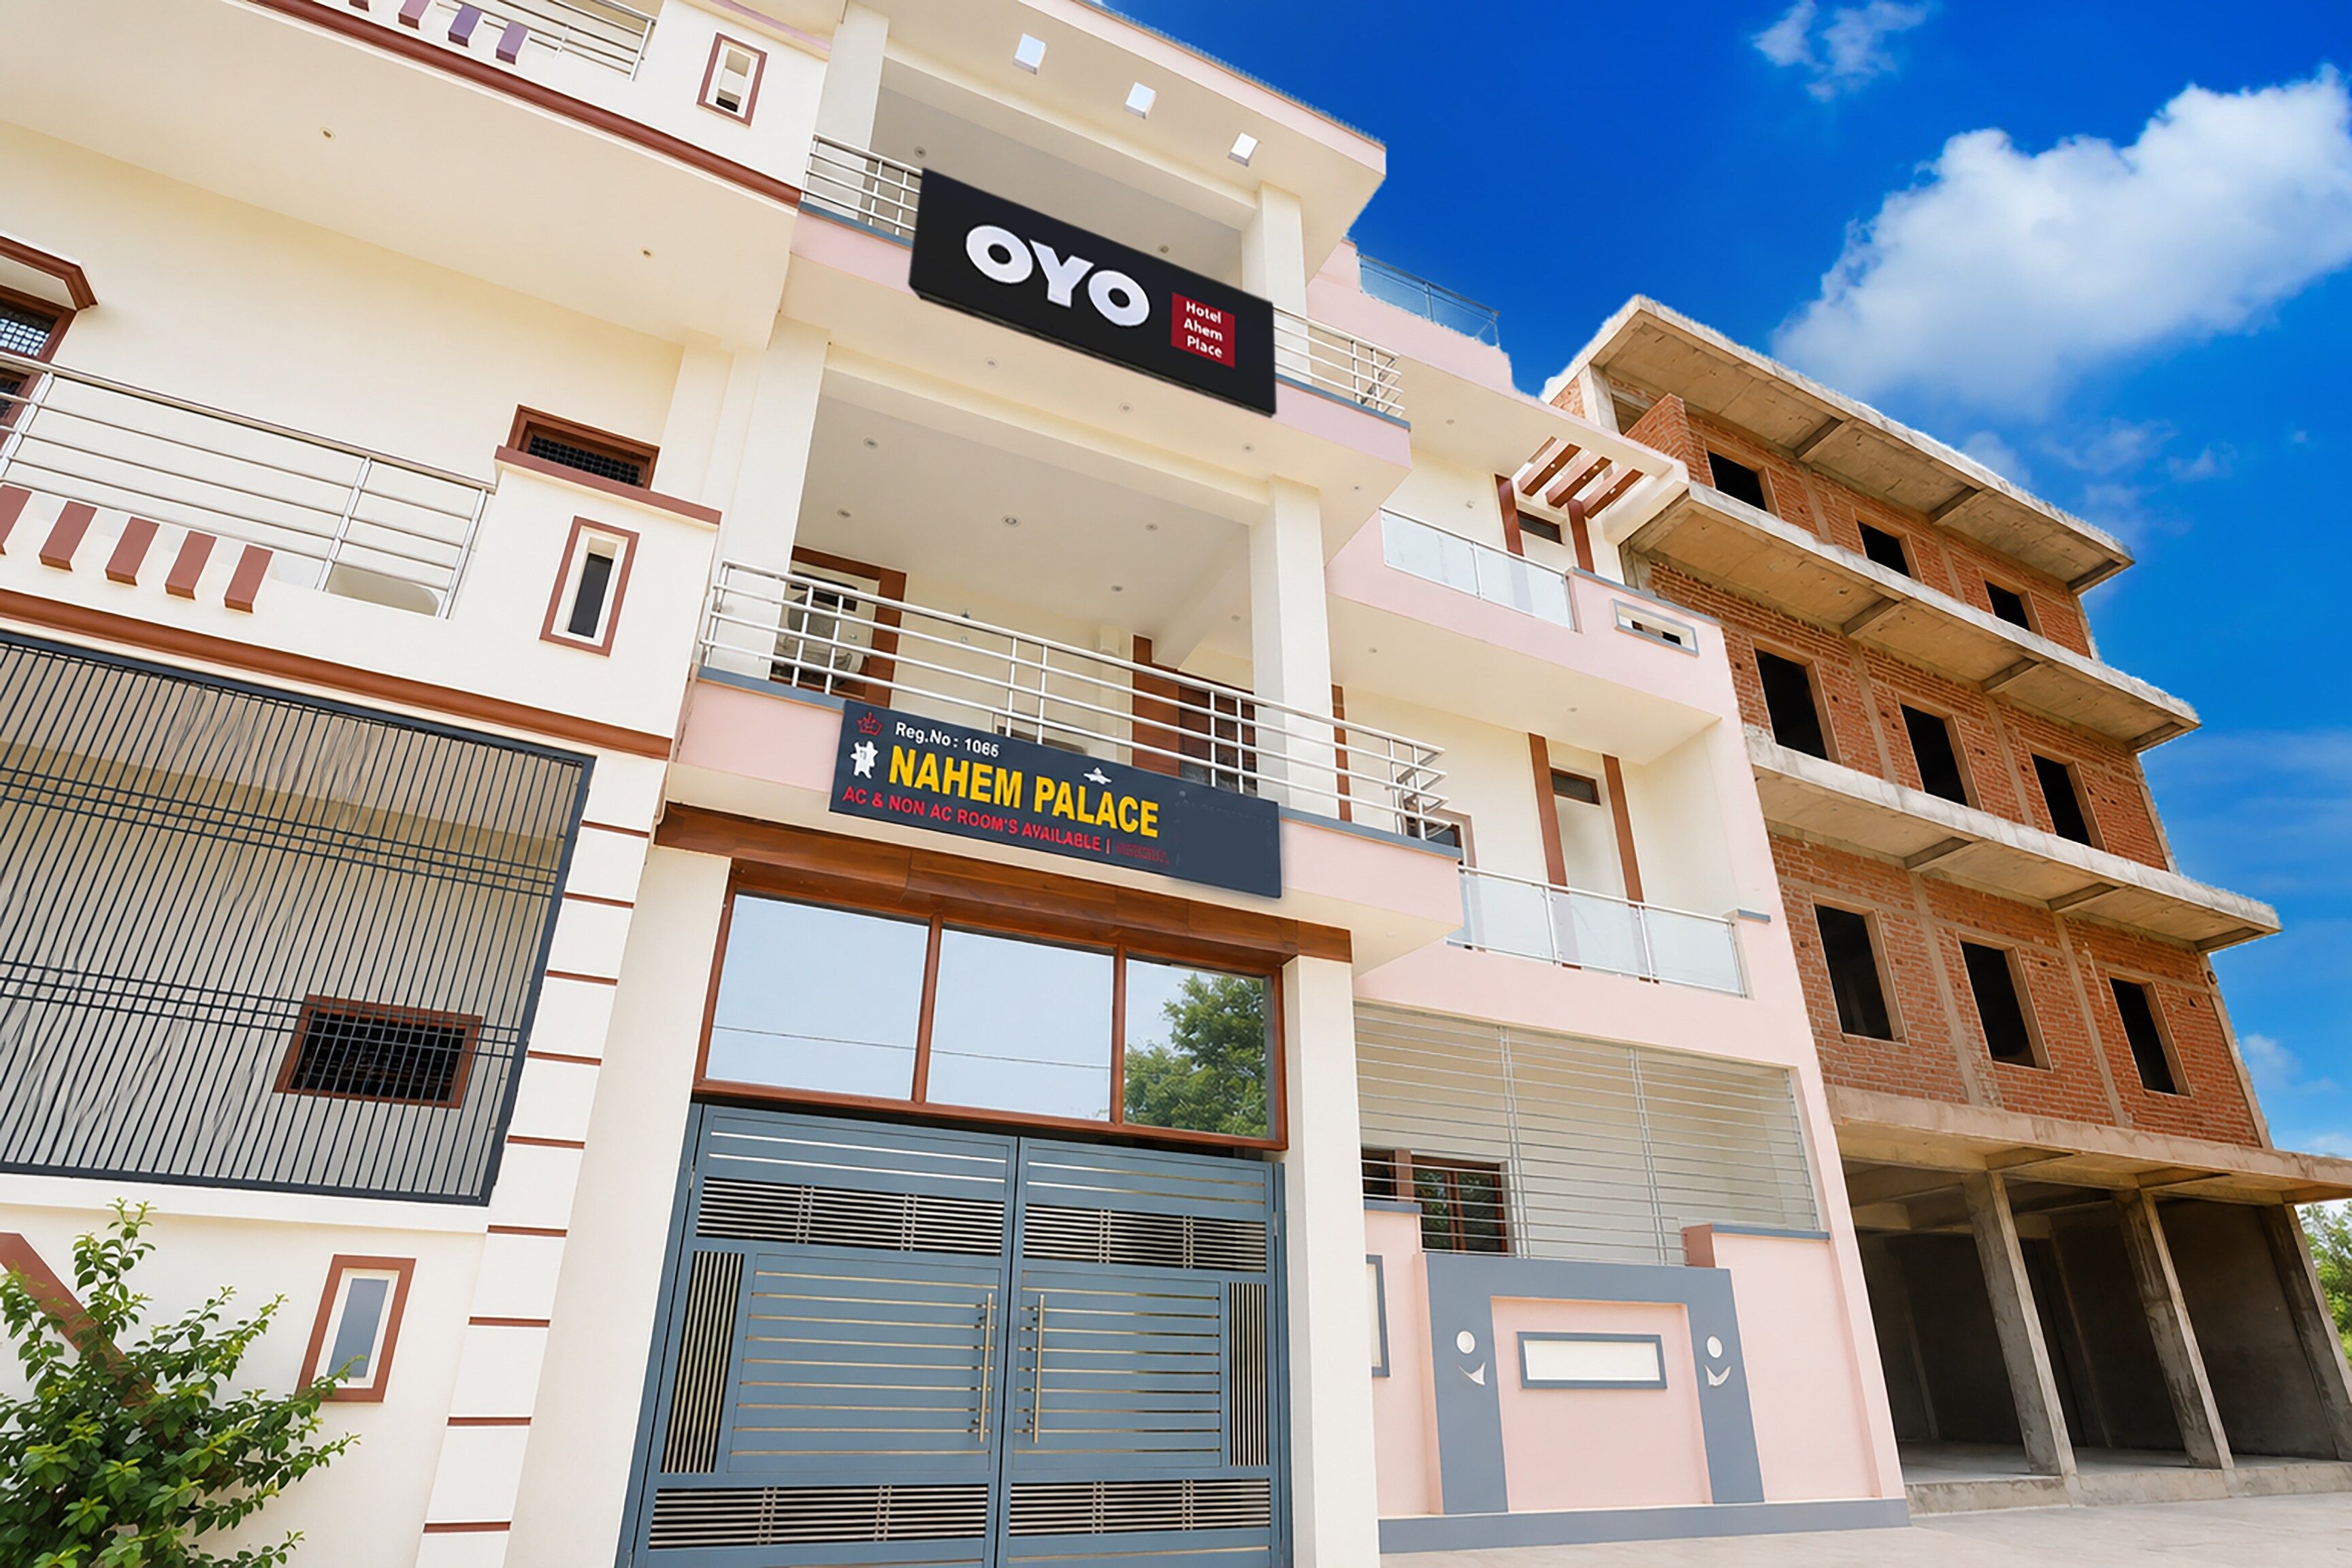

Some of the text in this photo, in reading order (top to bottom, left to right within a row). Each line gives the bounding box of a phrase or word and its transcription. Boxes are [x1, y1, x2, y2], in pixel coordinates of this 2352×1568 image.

[965, 225, 1151, 327] OYO
[1183, 318, 1223, 342] Ahem
[1186, 300, 1222, 324] Hotel
[1186, 334, 1223, 359] Place
[888, 745, 1023, 809] NAHEM
[1033, 774, 1159, 838] PALACE
[842, 785, 868, 804] AC
[871, 791, 883, 808] &
[888, 795, 926, 817] NON
[929, 803, 953, 821] AC
[957, 808, 1019, 834] ROOM'S
[1021, 821, 1102, 851] AVAILABLE
